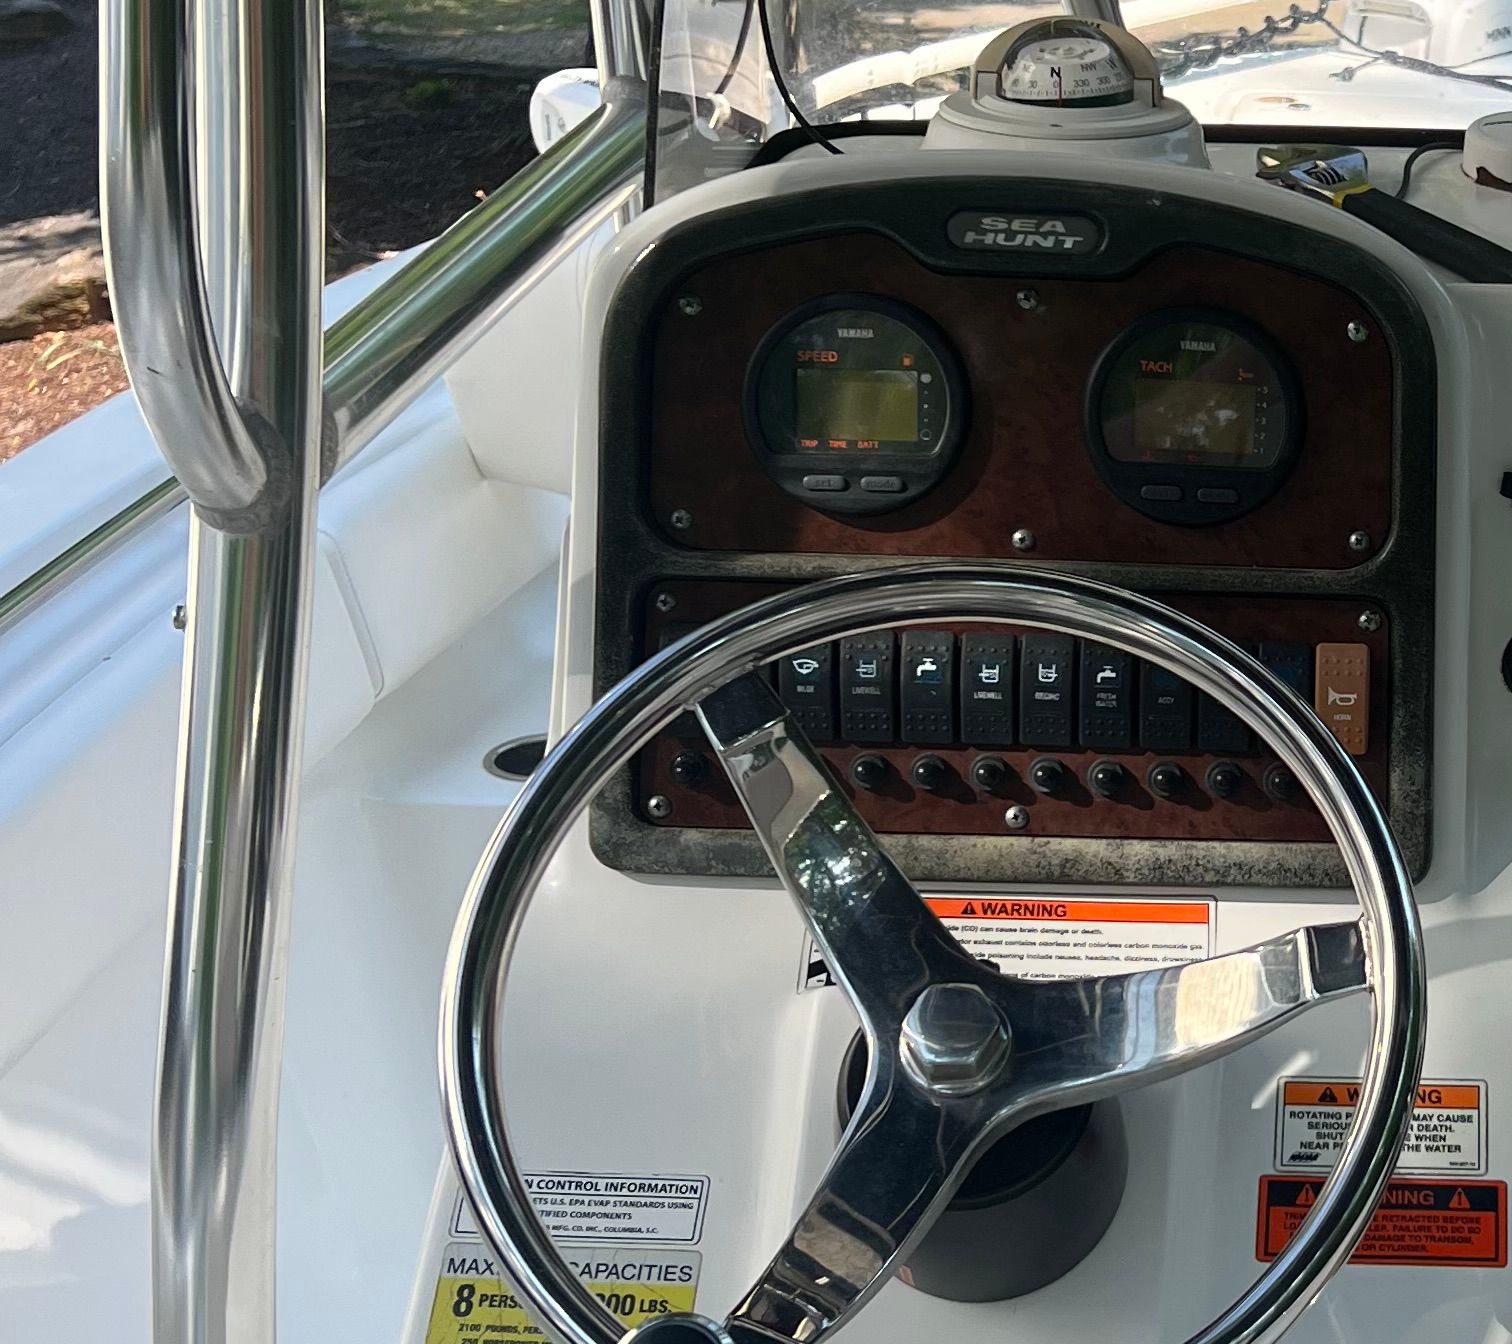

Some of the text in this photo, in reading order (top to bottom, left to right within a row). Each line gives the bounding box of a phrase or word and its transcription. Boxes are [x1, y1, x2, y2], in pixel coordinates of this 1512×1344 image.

[1050, 66, 1061, 78] N
[1080, 63, 1097, 72] NW
[1029, 79, 1038, 89] 30
[1073, 79, 1090, 88] 330
[980, 216, 1067, 233] SEA
[963, 231, 1084, 249] HUNT
[837, 328, 875, 339] YAMAHA
[1181, 340, 1216, 352] YAMAHA
[797, 351, 839, 362] SPEED
[1140, 360, 1172, 373] TACH
[980, 902, 1067, 918] WARNING
[1289, 1111, 1342, 1120] ROTATING
[1437, 1114, 1473, 1123] CAUSE
[1316, 1132, 1344, 1140] SHUT
[1415, 1134, 1447, 1143] WHEN
[1300, 1141, 1329, 1150] NEAR
[1425, 1144, 1462, 1153] WATER
[537, 1179, 601, 1191] CONTROL
[605, 1181, 699, 1194] INFORMATION
[587, 1199, 611, 1207] EVAP
[613, 1200, 666, 1209] STANDARDS
[667, 1201, 694, 1209] USING
[570, 1210, 633, 1220] COMPONENTS
[569, 1261, 693, 1283] APACITIES
[452, 1283, 476, 1317] 8
[638, 1299, 673, 1313] LBS.
